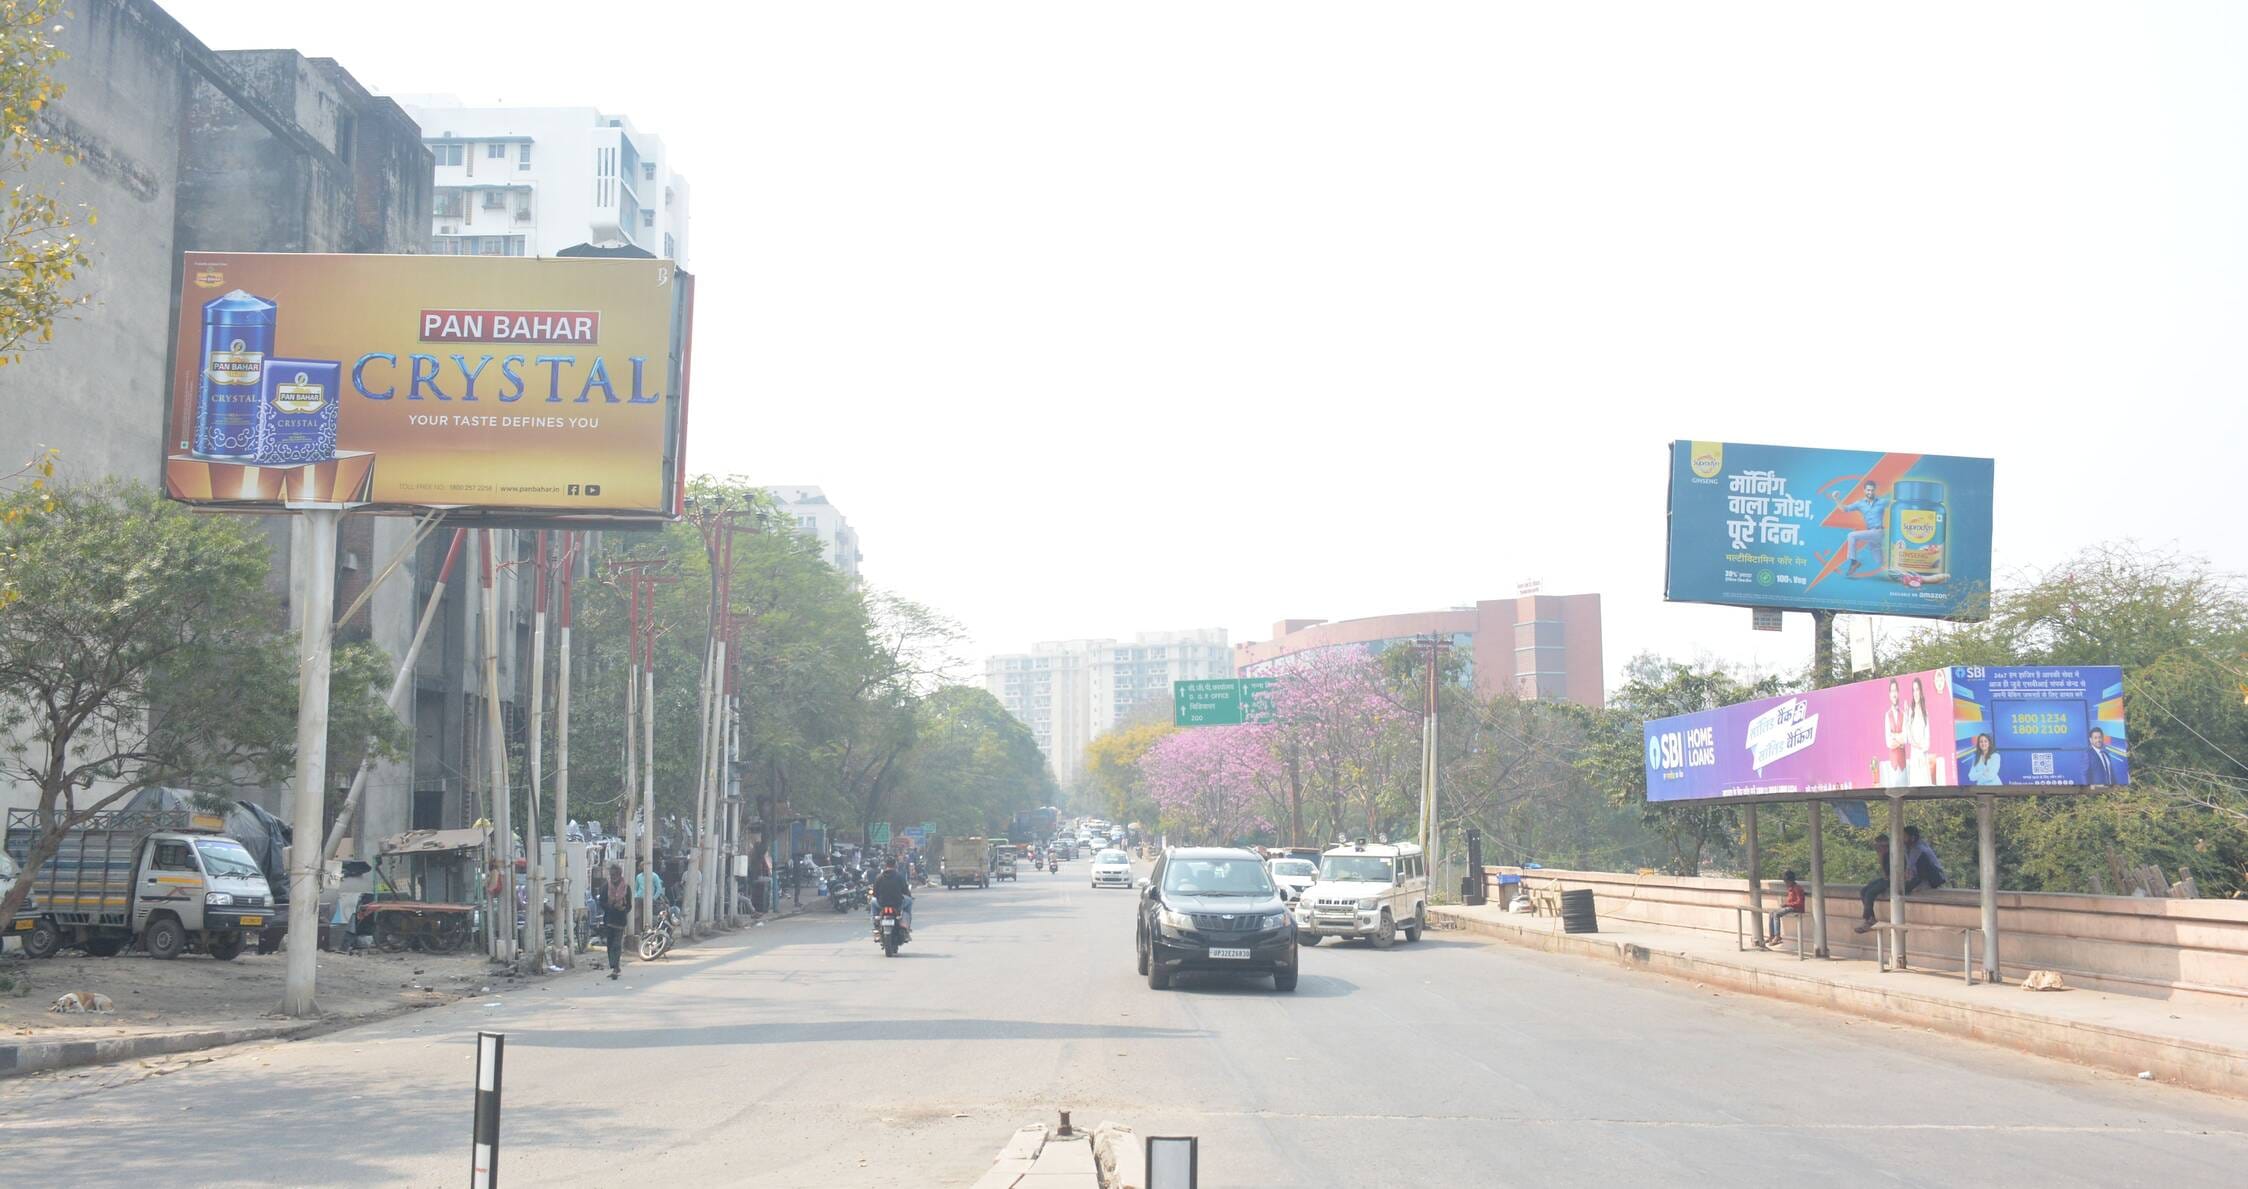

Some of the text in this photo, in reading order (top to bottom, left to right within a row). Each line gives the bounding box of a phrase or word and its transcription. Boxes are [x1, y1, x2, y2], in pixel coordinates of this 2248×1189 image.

[424, 314, 592, 340] PAN BAHAR
[214, 363, 260, 371] PAN BAHAR
[352, 352, 660, 404] CRYSTAL
[211, 394, 257, 403] CRYSTAL
[280, 393, 319, 401] PAN BAHAR
[277, 419, 318, 428] CRYSTAL
[408, 415, 599, 429] YOUR TASTE DEFINES YOU
[1691, 477, 1718, 485] GINSENG
[1728, 470, 1787, 495] मॉर्निंग
[500, 485, 560, 493] www.panbahar.in
[1728, 493, 1814, 520] वाला जोश,
[1727, 515, 1805, 550] पूरे दिन.
[1919, 592, 1947, 600] amazon
[1966, 667, 1985, 678] SBI
[2011, 713, 2067, 723] 1800 1234
[2012, 724, 2067, 734] 1800 2100
[1687, 727, 1713, 748] HOME
[1660, 731, 1683, 769] SBI
[1689, 747, 1715, 767] LOANS
